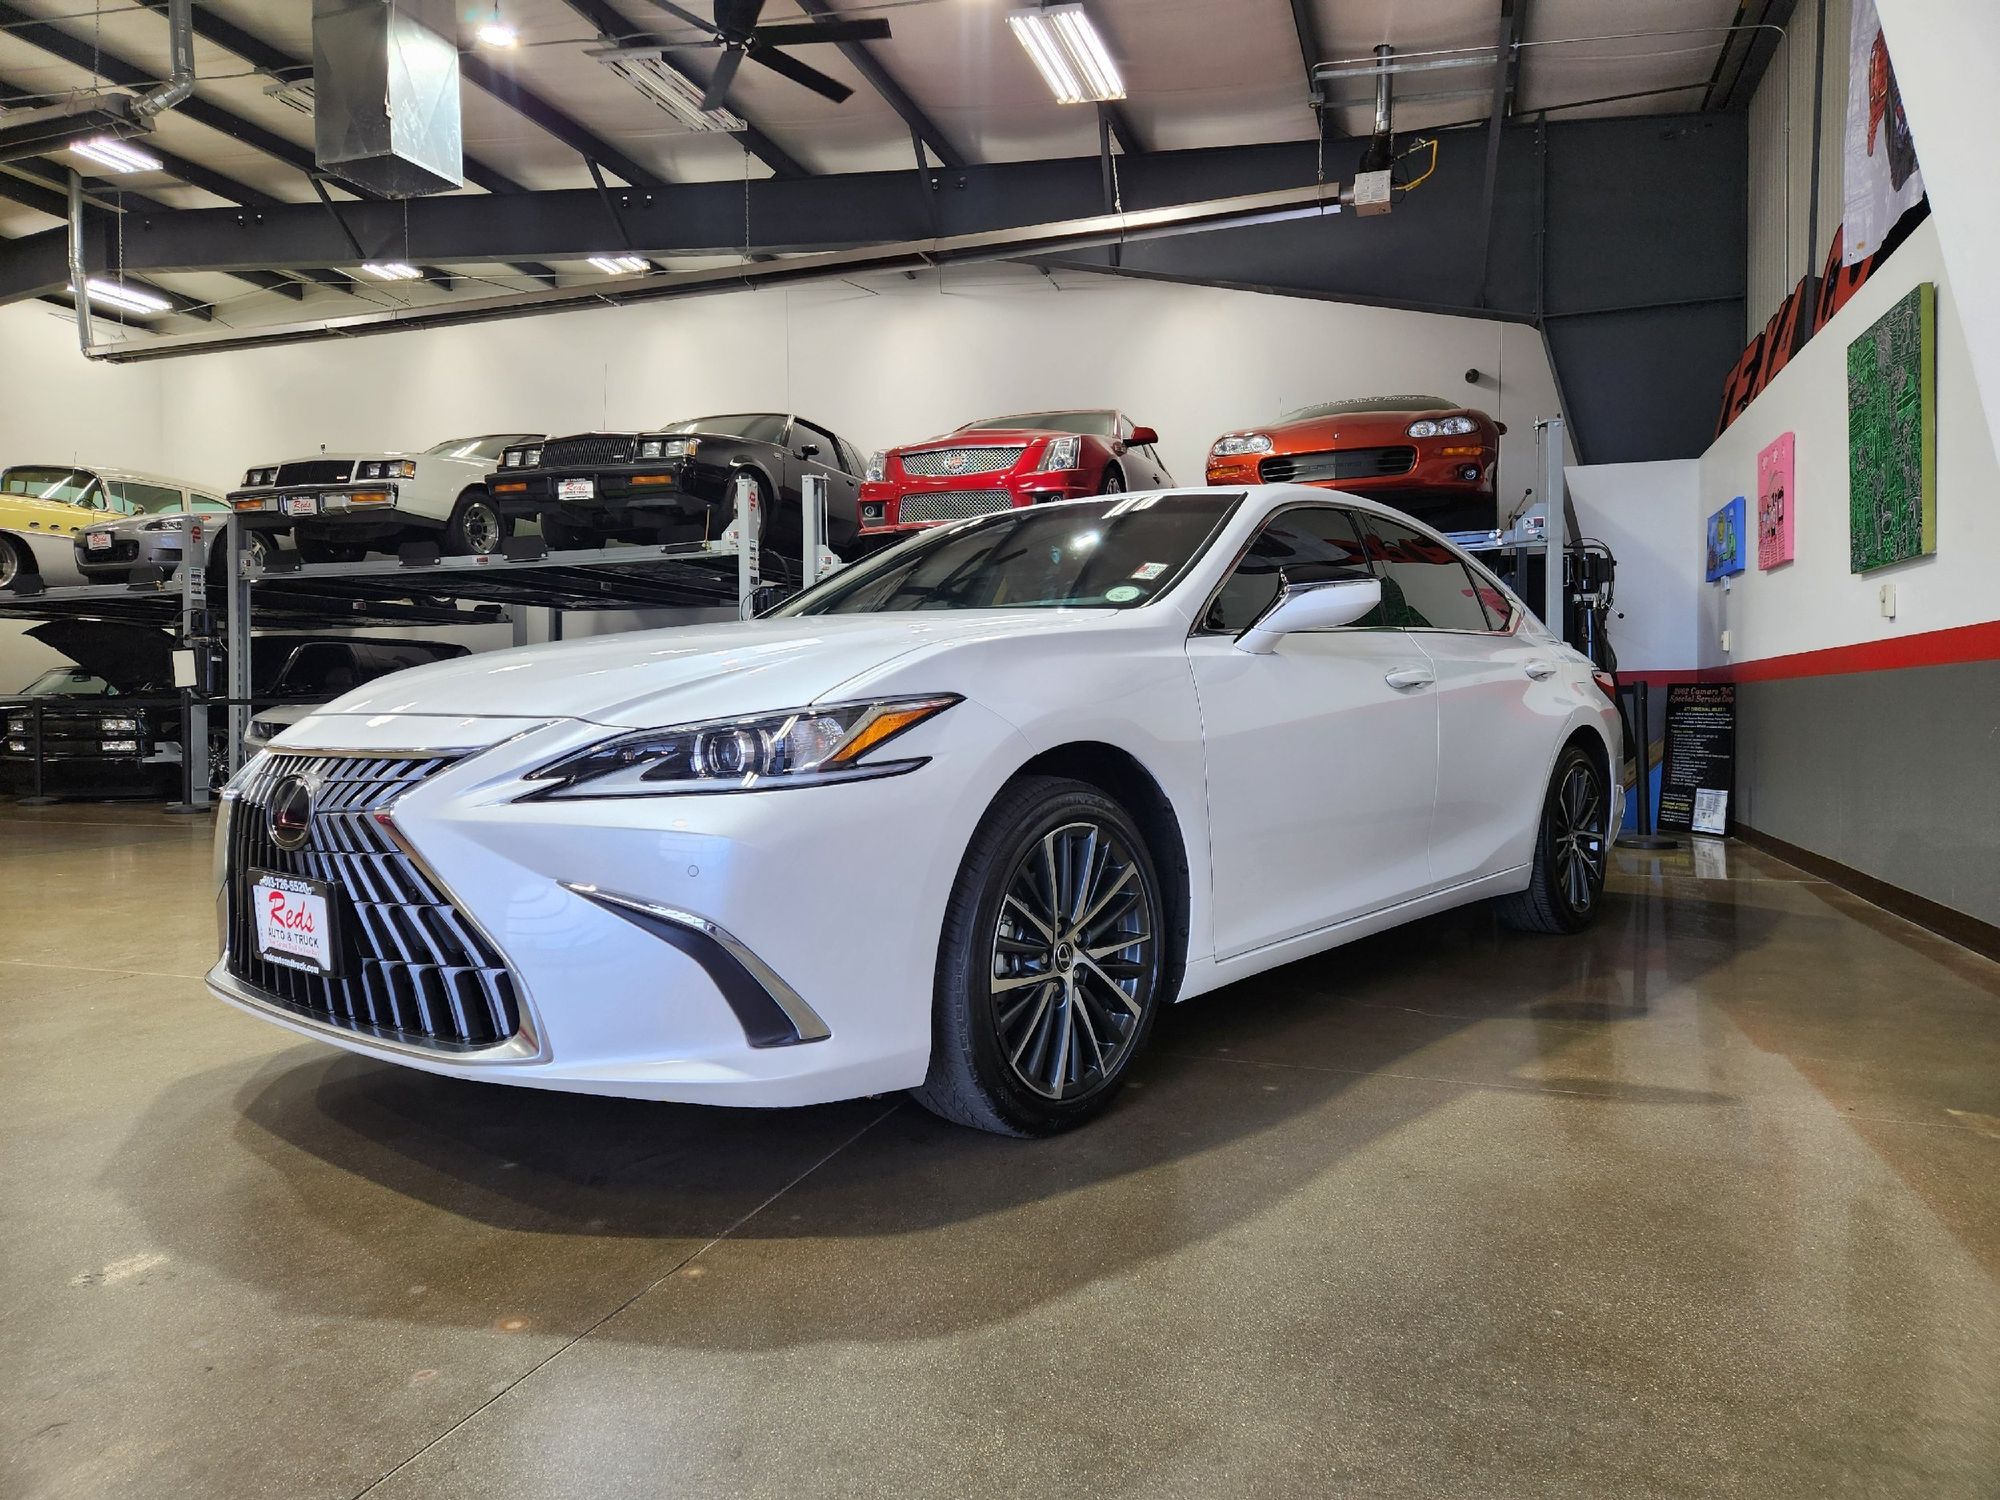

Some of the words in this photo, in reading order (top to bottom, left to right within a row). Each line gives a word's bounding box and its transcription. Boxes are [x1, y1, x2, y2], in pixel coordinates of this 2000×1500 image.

[1690, 686, 1719, 695] Camaro
[1669, 694, 1695, 704] Special
[1696, 694, 1721, 703] Service
[268, 891, 315, 933] Reds
[268, 927, 286, 940] AUTO
[287, 931, 292, 941] &
[293, 932, 319, 948] TRUCK
